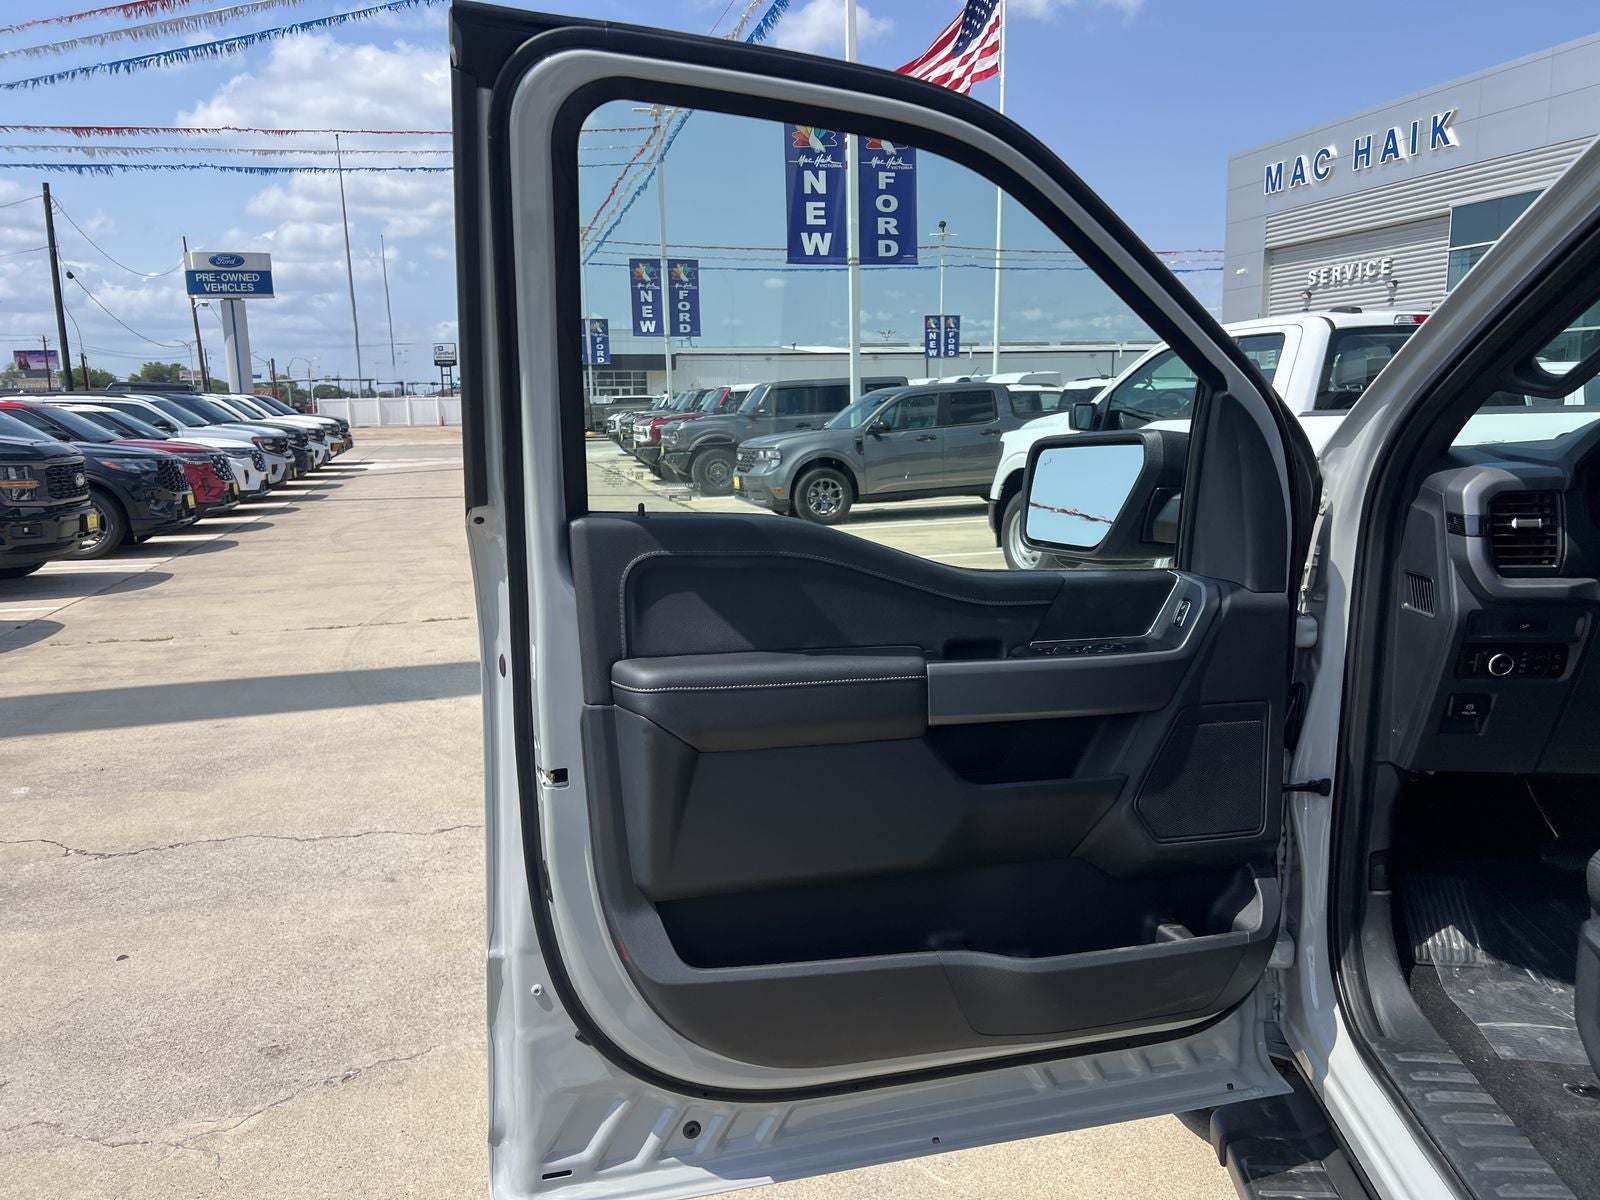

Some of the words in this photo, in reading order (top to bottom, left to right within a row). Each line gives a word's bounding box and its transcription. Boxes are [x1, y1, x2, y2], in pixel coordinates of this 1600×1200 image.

[1264, 146, 1335, 195] MAC
[1352, 109, 1458, 171] HAIK
[800, 170, 833, 256] NEW
[875, 171, 899, 257] FORD
[215, 255, 236, 265] Ford
[1307, 258, 1391, 286] SERVICE
[203, 283, 255, 292] VEHICLES
[640, 290, 656, 333] NEW
[677, 290, 692, 333] FORD
[595, 336, 605, 363] FORD
[928, 332, 938, 357] NEW
[947, 332, 956, 356] FORD
